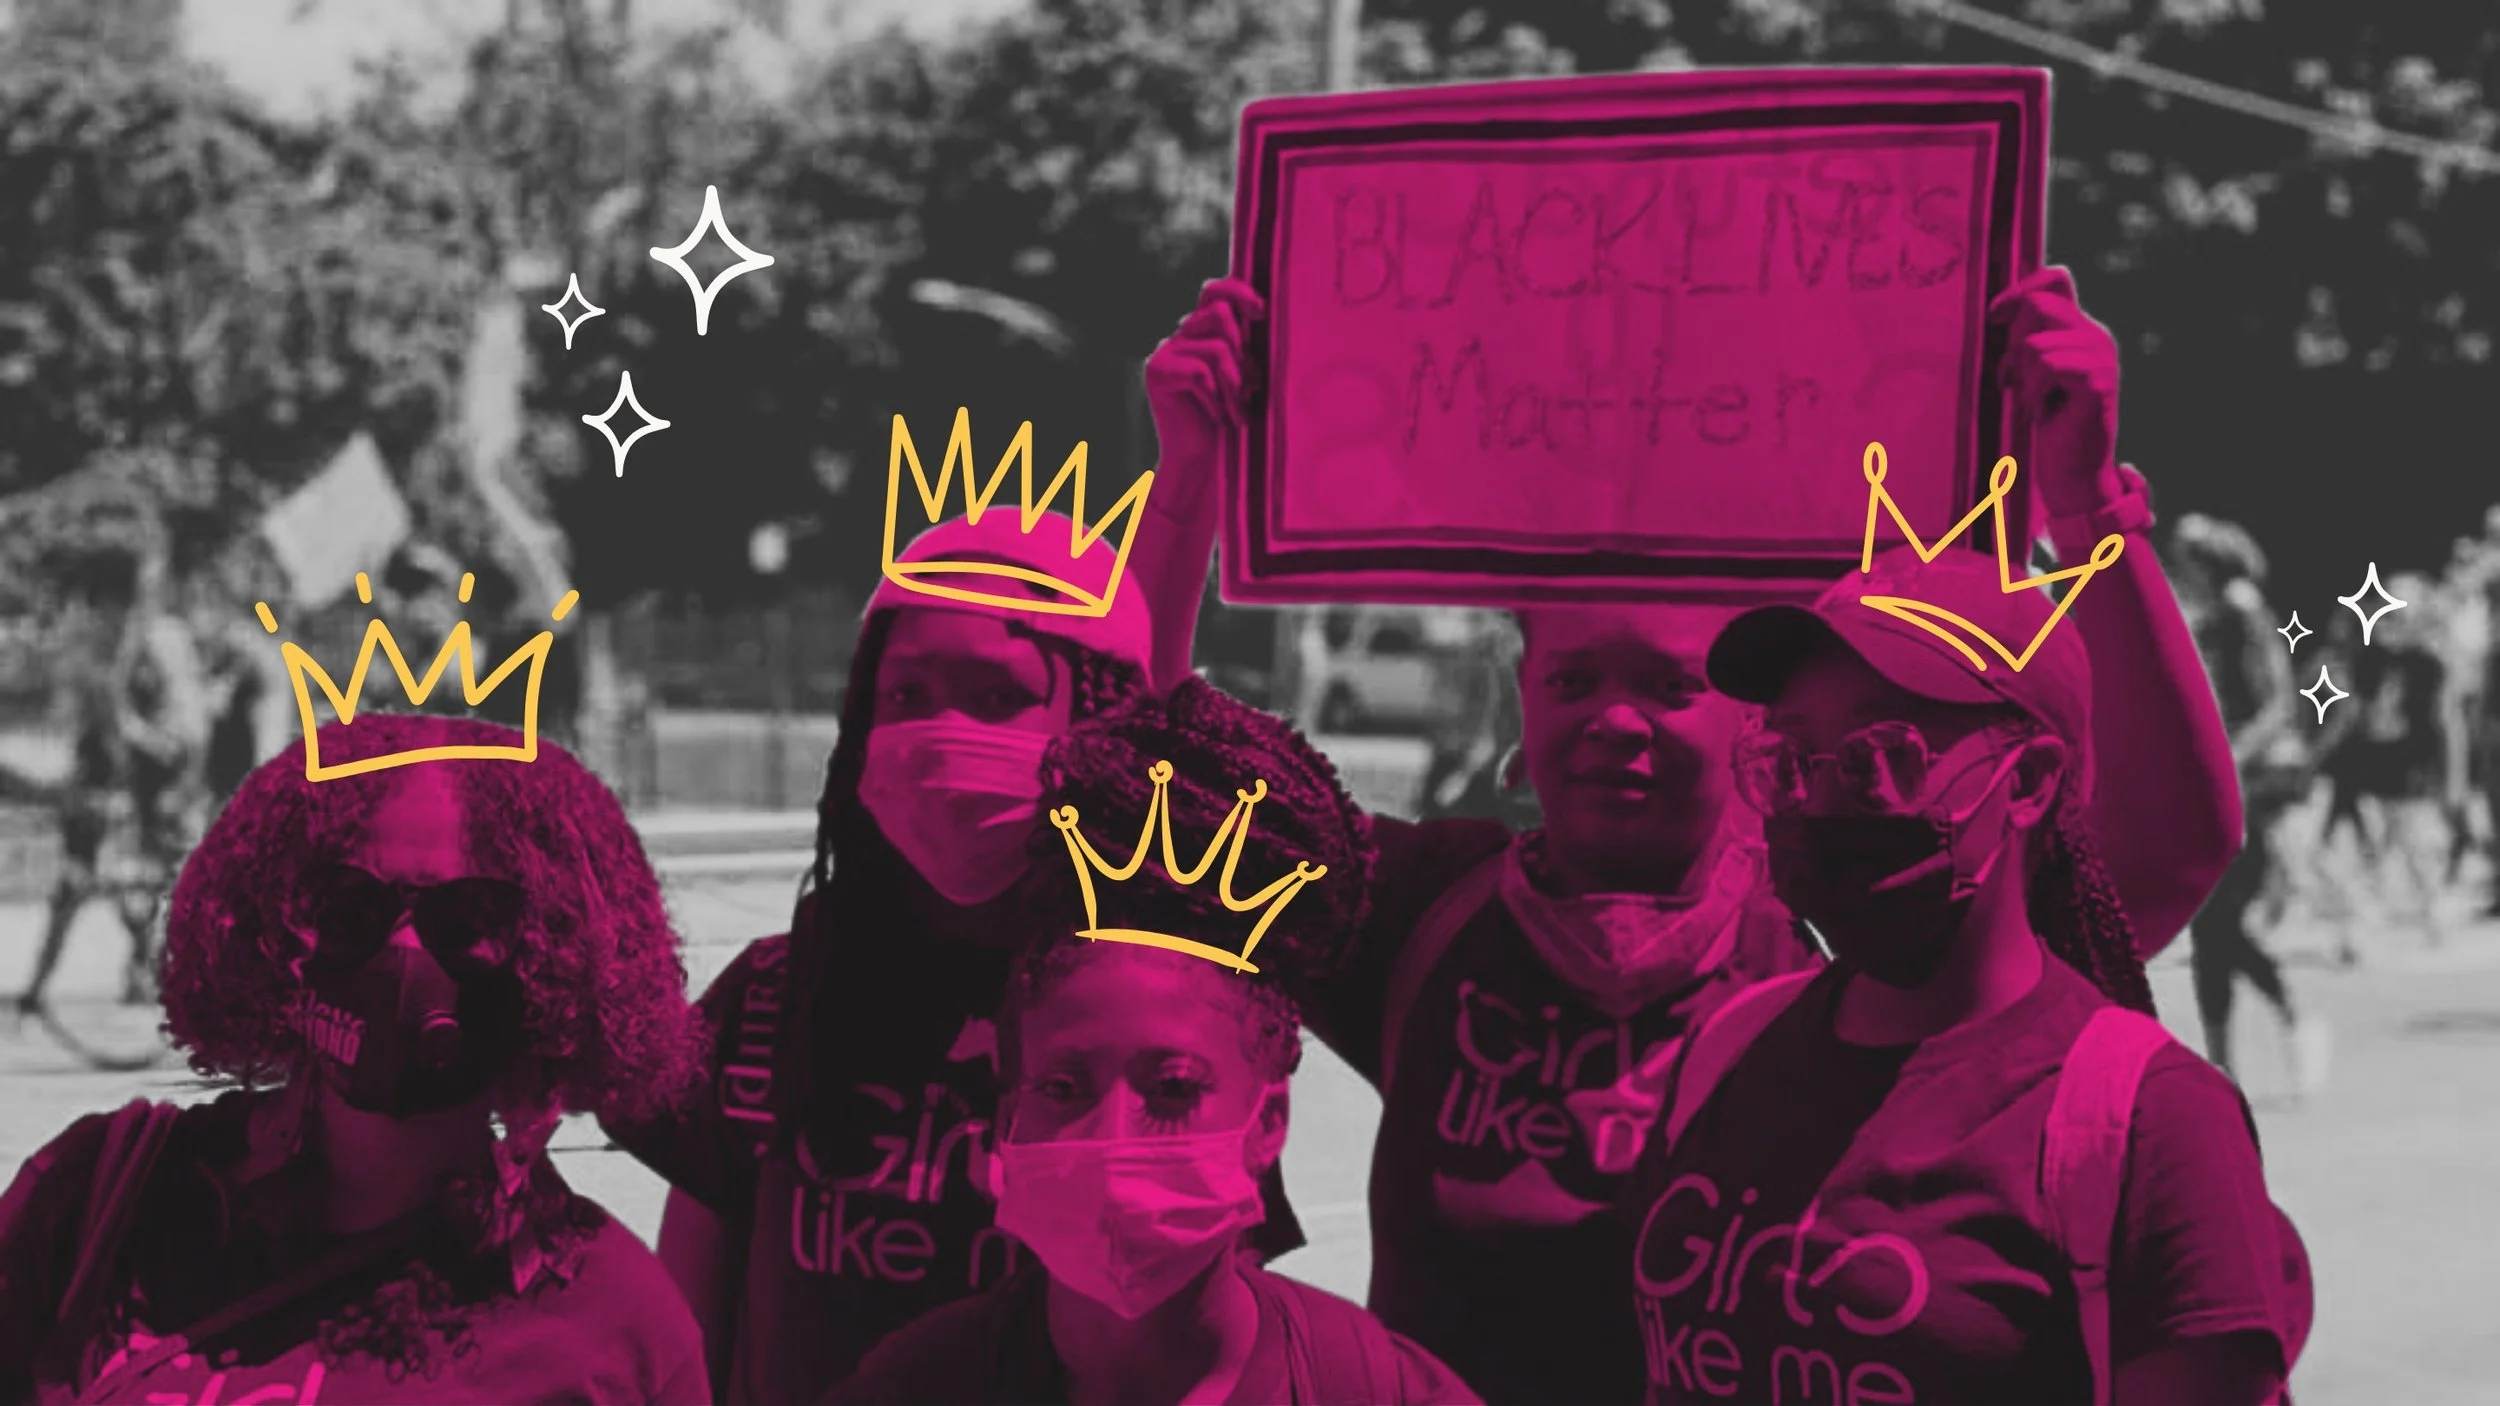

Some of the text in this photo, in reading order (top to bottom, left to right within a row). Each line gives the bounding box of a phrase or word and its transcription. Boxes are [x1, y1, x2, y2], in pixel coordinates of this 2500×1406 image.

[1333, 176, 1963, 309] BLACK LIVES
[1402, 334, 1824, 456] Matter
[1437, 1069, 1572, 1158] like
[791, 1186, 937, 1282] like
[1634, 1172, 1930, 1336] Girls
[1770, 1344, 1915, 1406] me
